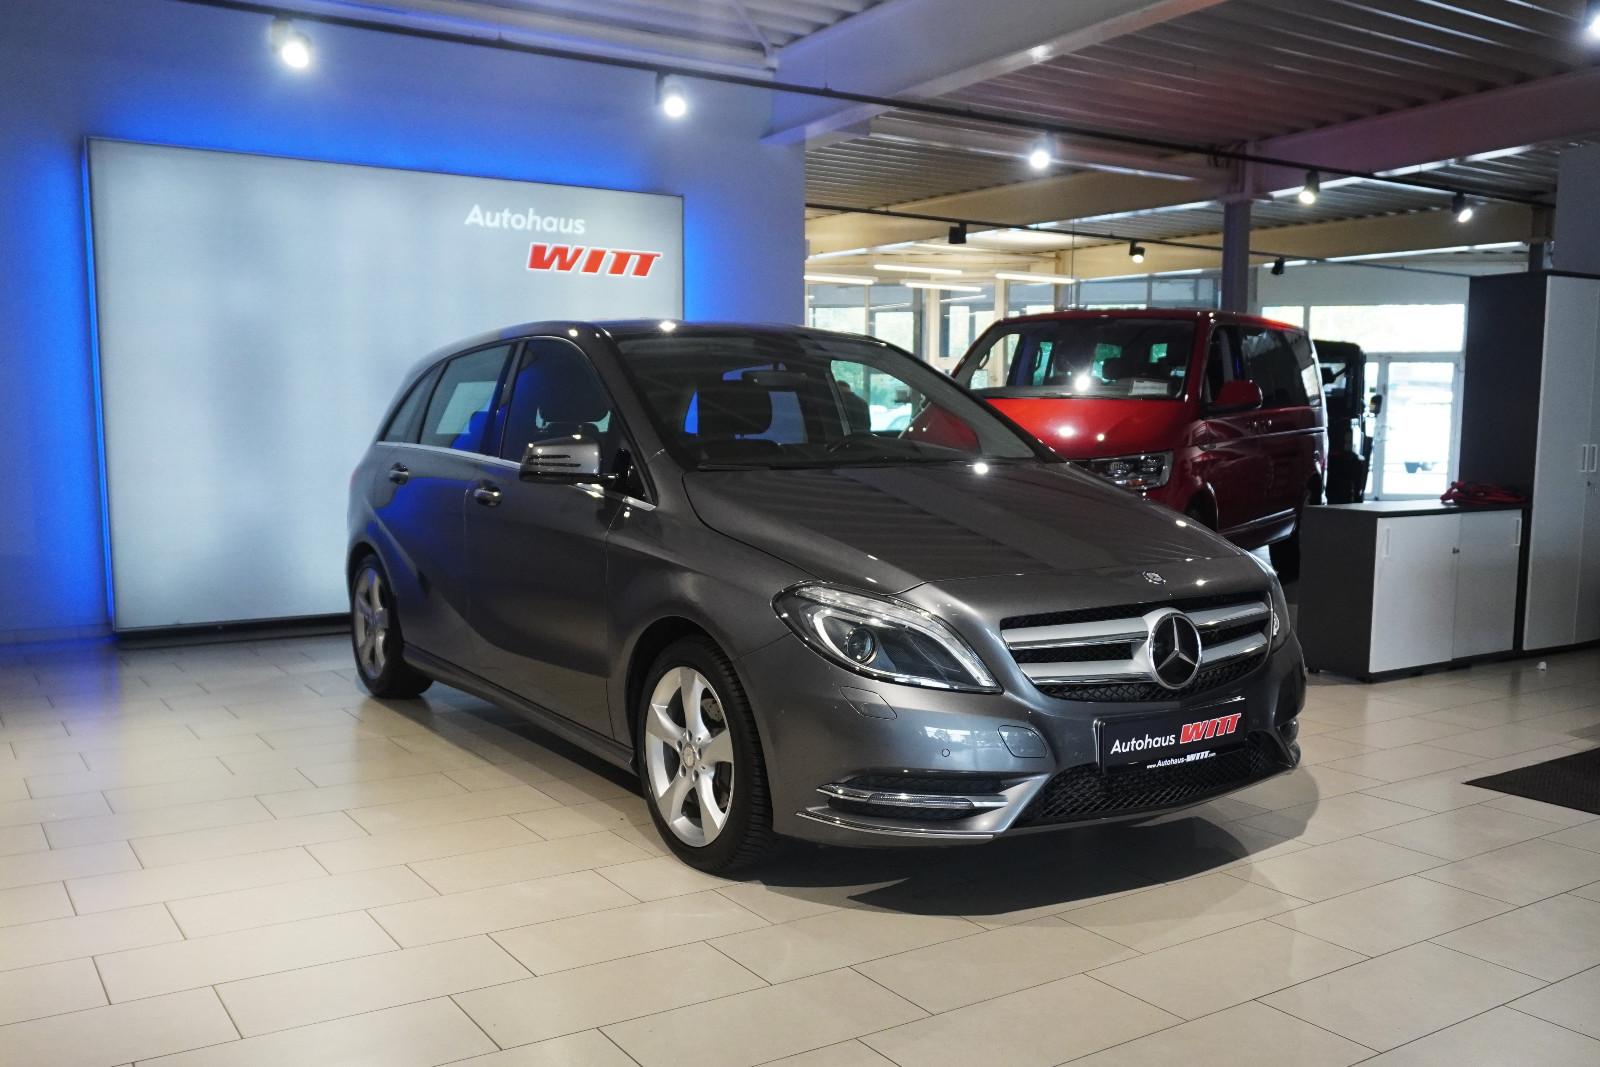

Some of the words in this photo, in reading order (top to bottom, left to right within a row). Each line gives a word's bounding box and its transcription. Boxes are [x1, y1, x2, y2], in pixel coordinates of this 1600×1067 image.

[464, 204, 585, 234] Autohaus
[526, 242, 663, 277] WITT
[1110, 734, 1176, 754] Autohaus
[1180, 713, 1241, 744] WITT
